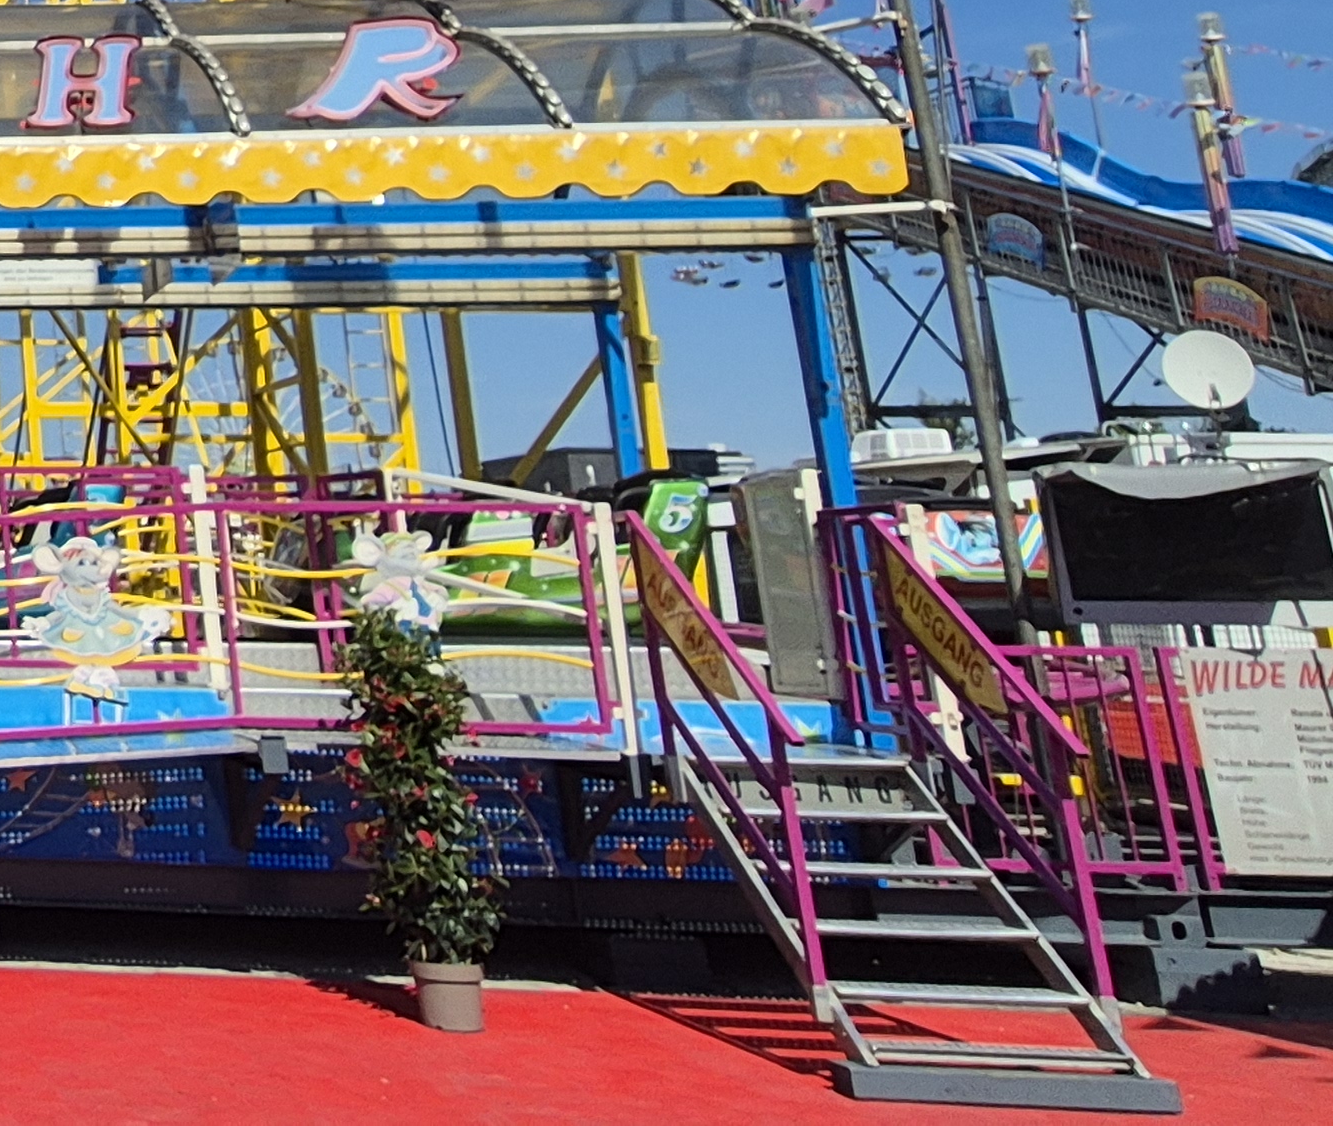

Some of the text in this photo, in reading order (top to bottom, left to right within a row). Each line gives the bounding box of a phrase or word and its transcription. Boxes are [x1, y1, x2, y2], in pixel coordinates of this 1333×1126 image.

[658, 492, 699, 534] 5
[895, 576, 985, 689] AUSGANG
[1190, 659, 1287, 697] WILDE
